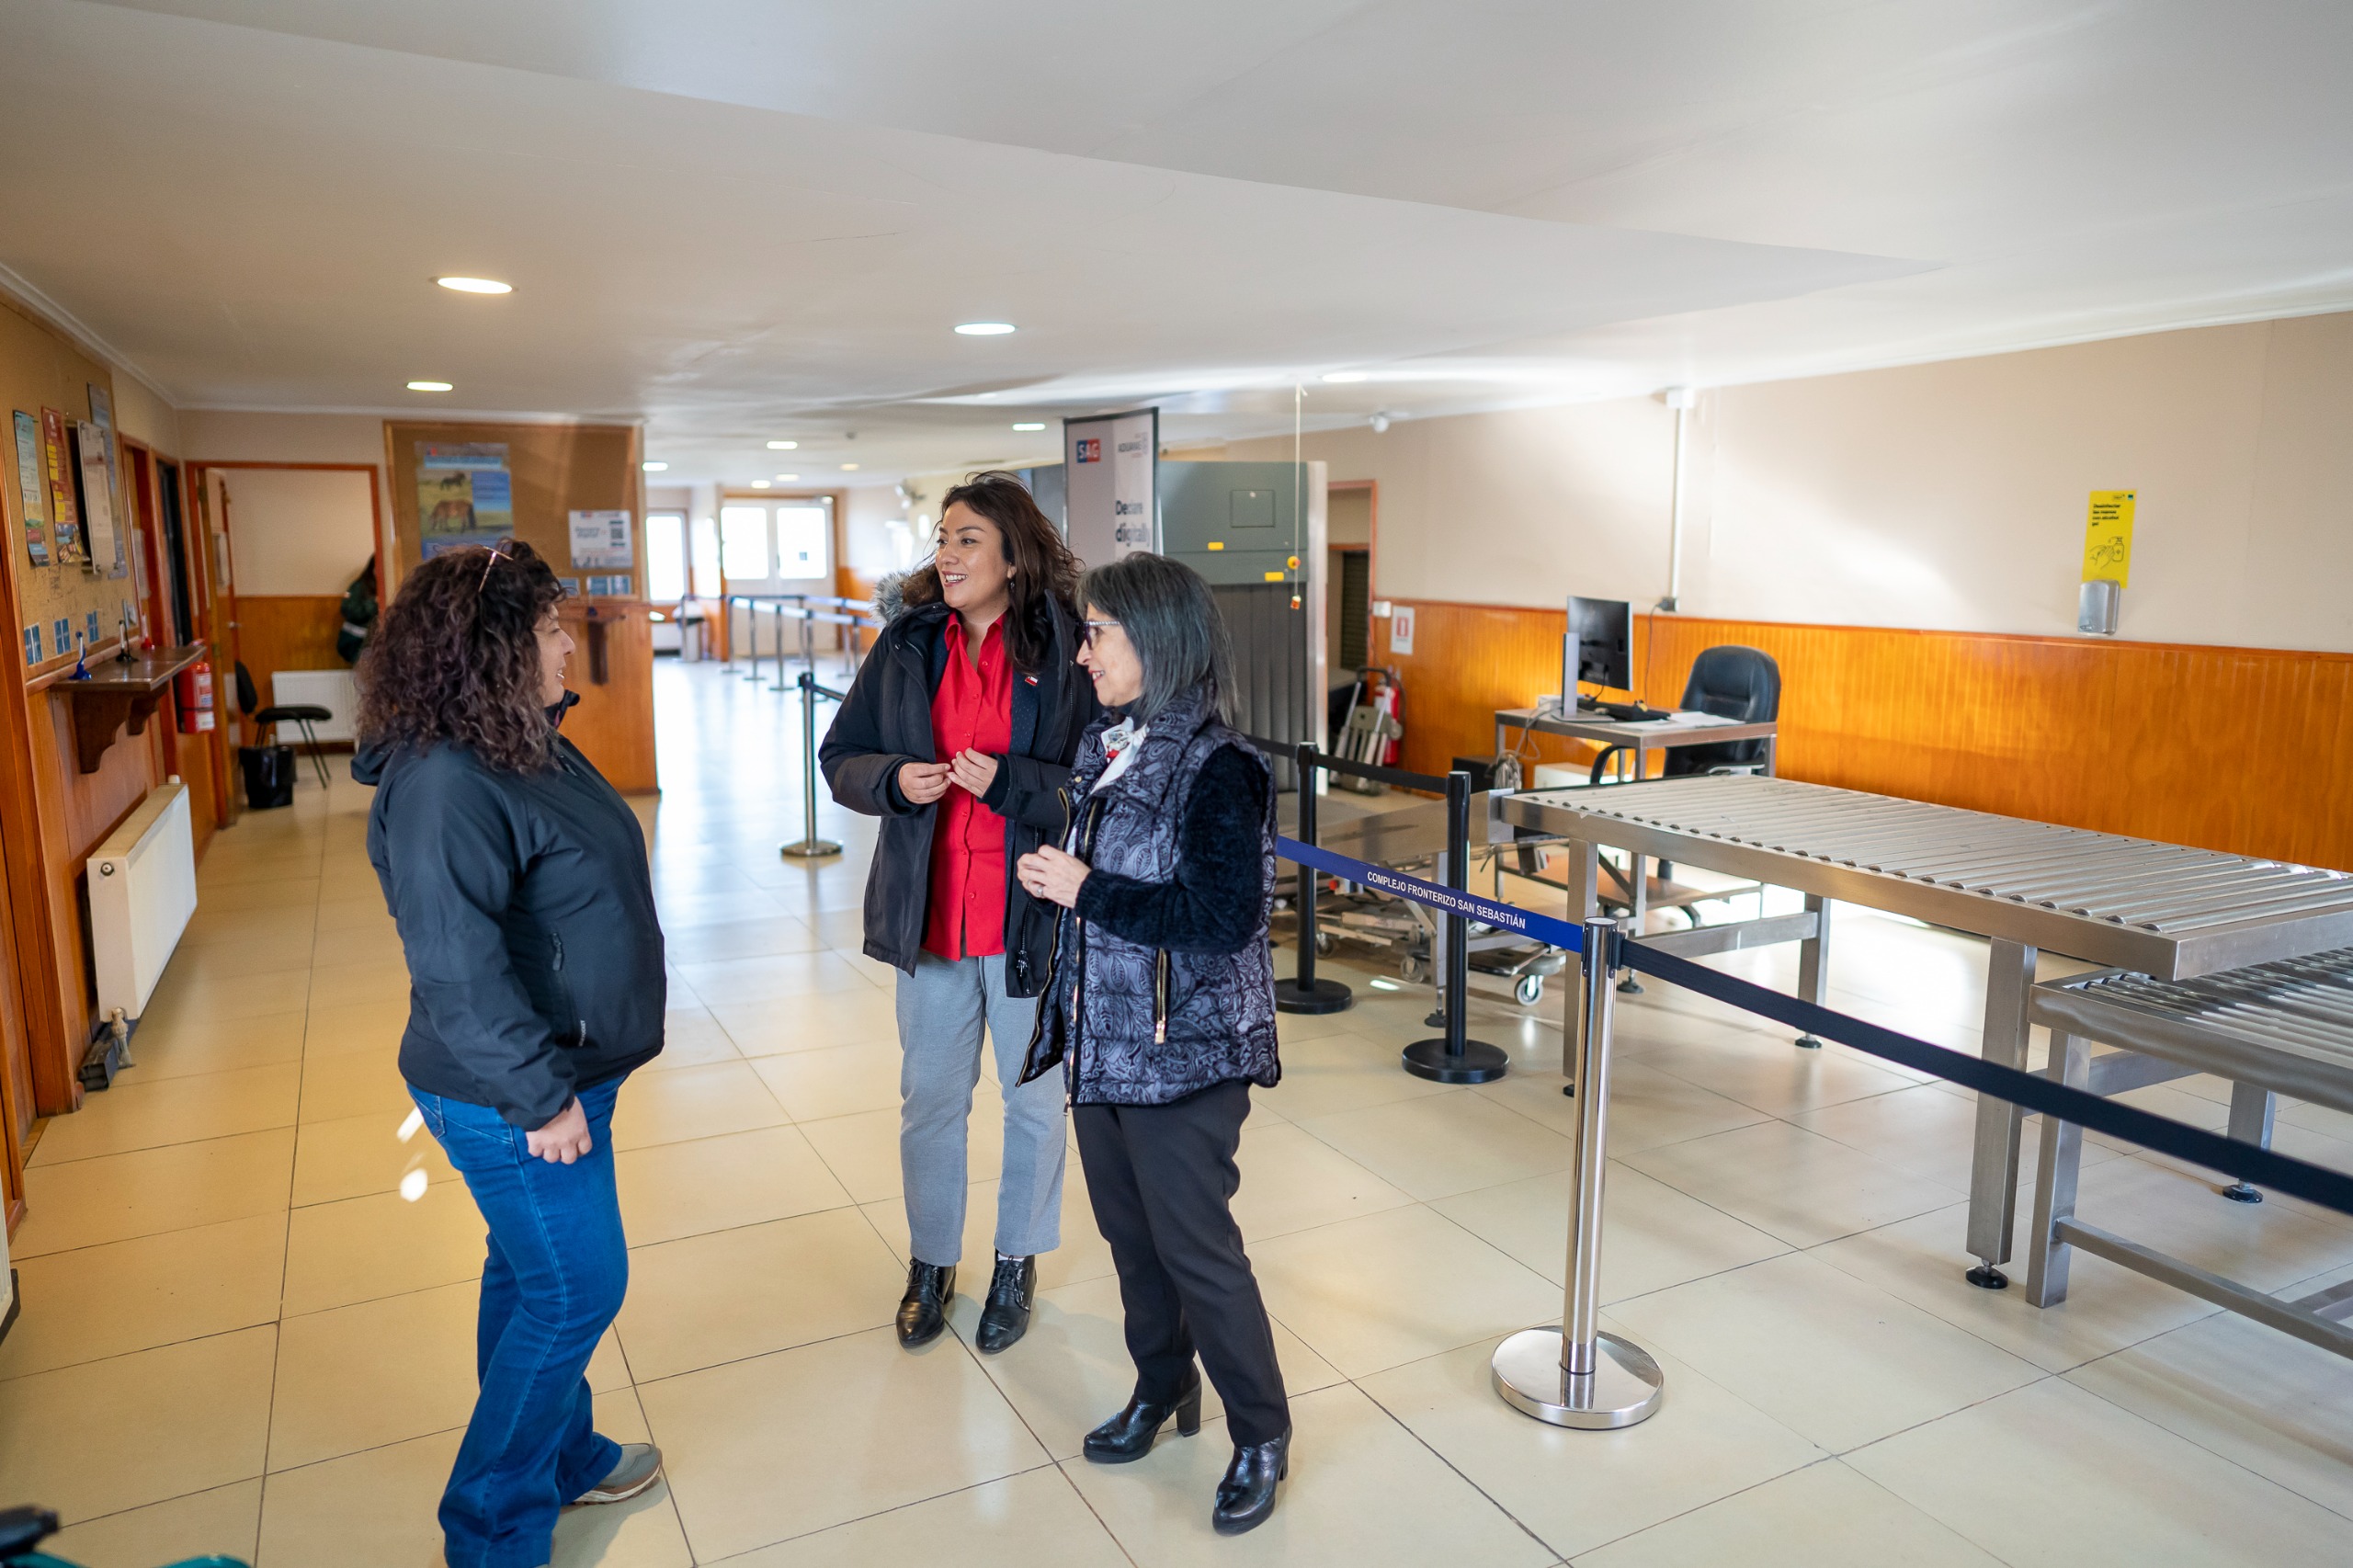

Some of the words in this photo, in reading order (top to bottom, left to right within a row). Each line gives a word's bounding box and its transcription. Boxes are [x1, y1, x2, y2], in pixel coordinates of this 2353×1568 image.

[1078, 442, 1100, 459] SAG
[1367, 871, 1406, 892] COMPLEJO
[1407, 883, 1456, 907] FRONTERIZO
[1458, 899, 1475, 914] SAN
[1476, 905, 1526, 929] SEBASTIÁN
